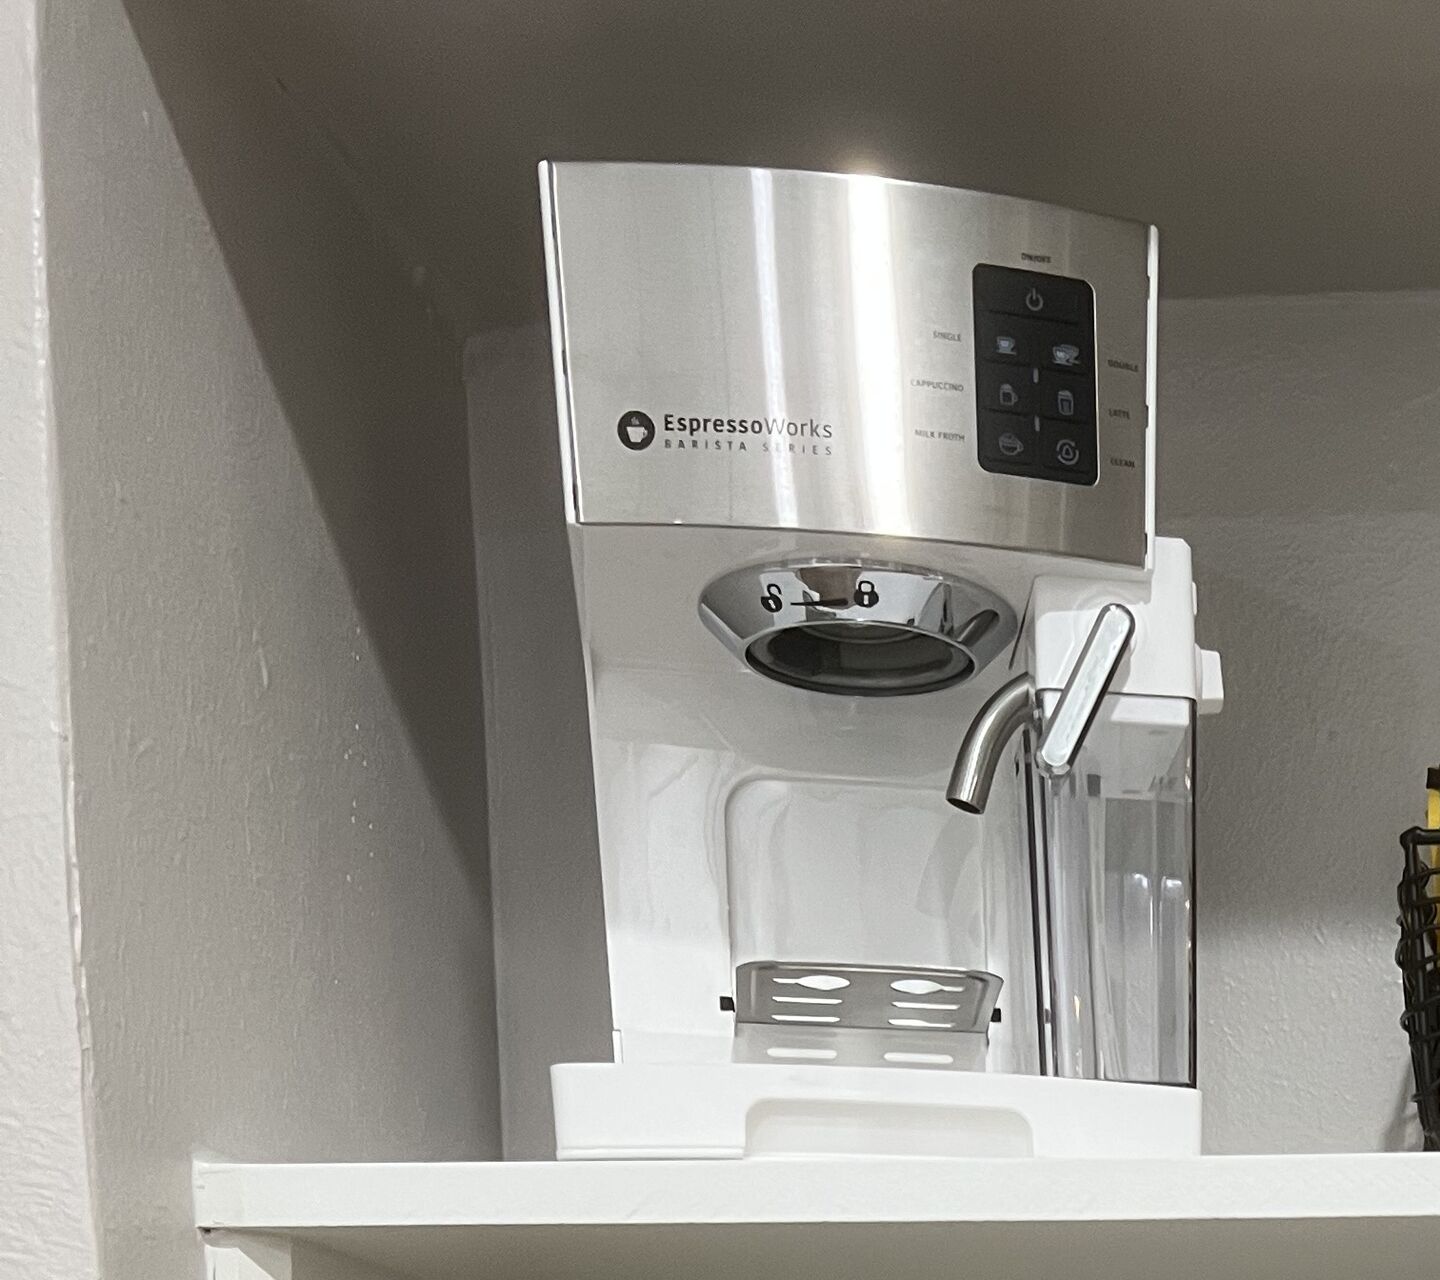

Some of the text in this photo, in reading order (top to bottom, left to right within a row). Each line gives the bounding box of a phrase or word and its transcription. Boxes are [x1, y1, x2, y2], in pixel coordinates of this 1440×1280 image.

[910, 379, 964, 393] CAPPUCCINO
[664, 414, 833, 439] EspressoWorks
[914, 429, 937, 440] MILK
[664, 439, 832, 456] BARISTA SERIES
